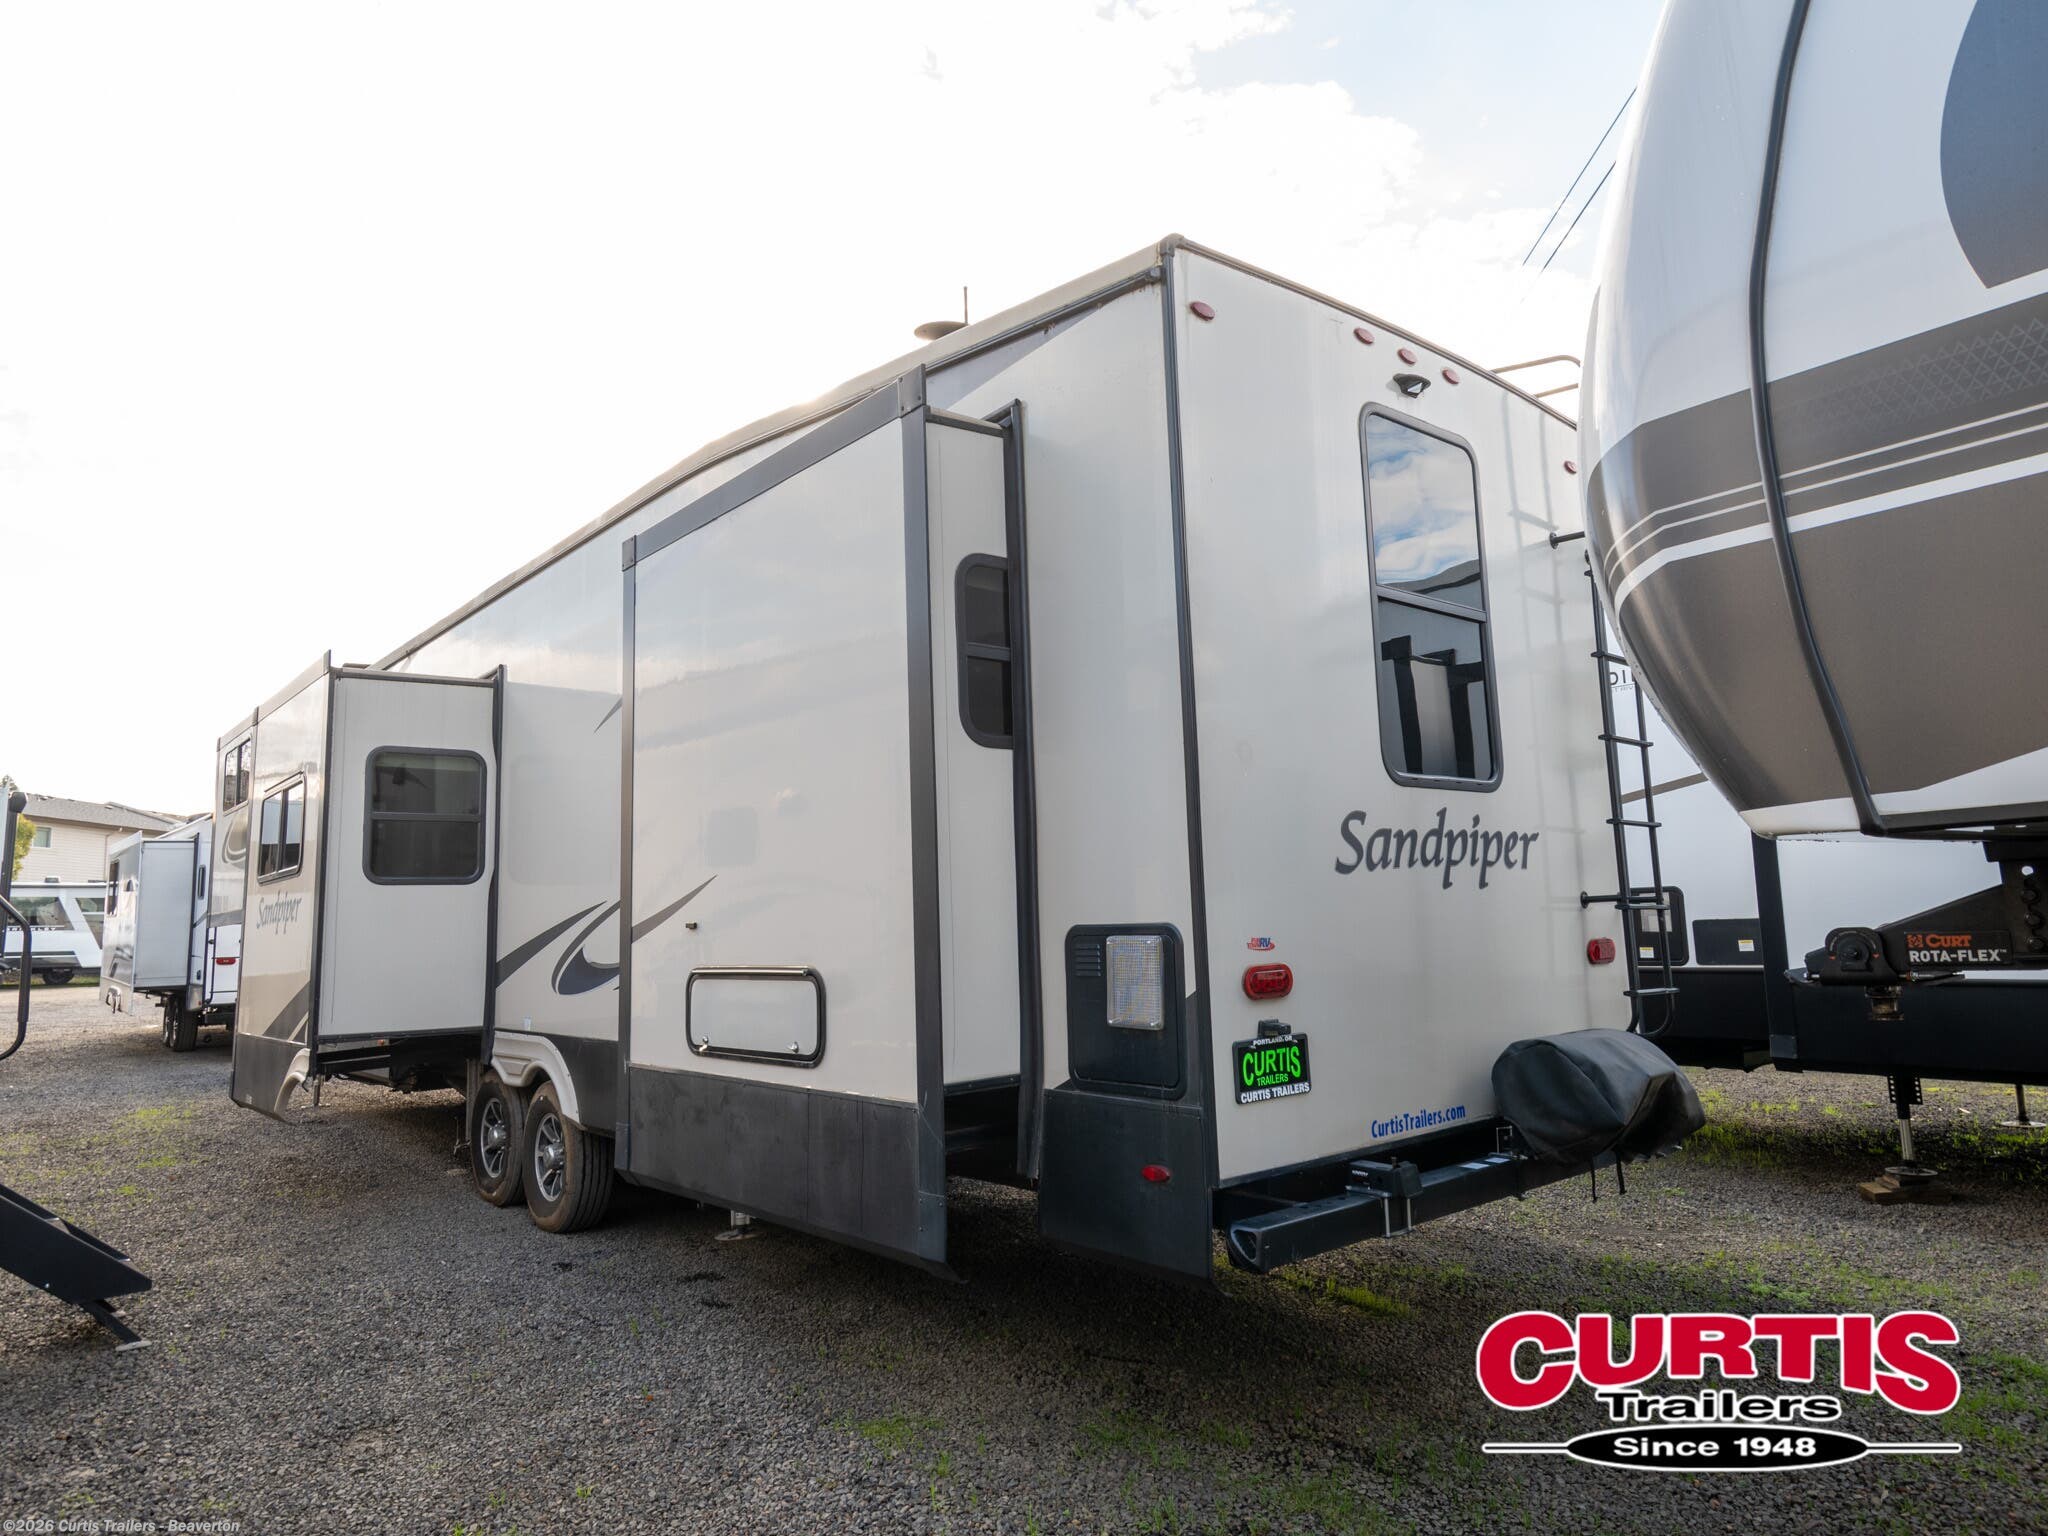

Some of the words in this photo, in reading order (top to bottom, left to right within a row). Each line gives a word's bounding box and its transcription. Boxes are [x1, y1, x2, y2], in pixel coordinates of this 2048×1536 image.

[1335, 807, 1540, 890] Sandpiper
[256, 890, 302, 934] Sandpiper
[1926, 934, 1972, 947] CURT
[1242, 1046, 1301, 1087] CURTIS
[1256, 1073, 1289, 1087] TRAILERS
[1240, 1090, 1271, 1104] CURTIS
[1272, 1082, 1310, 1098] TRAILERS
[1371, 1104, 1466, 1138] CurtisTrailers.com
